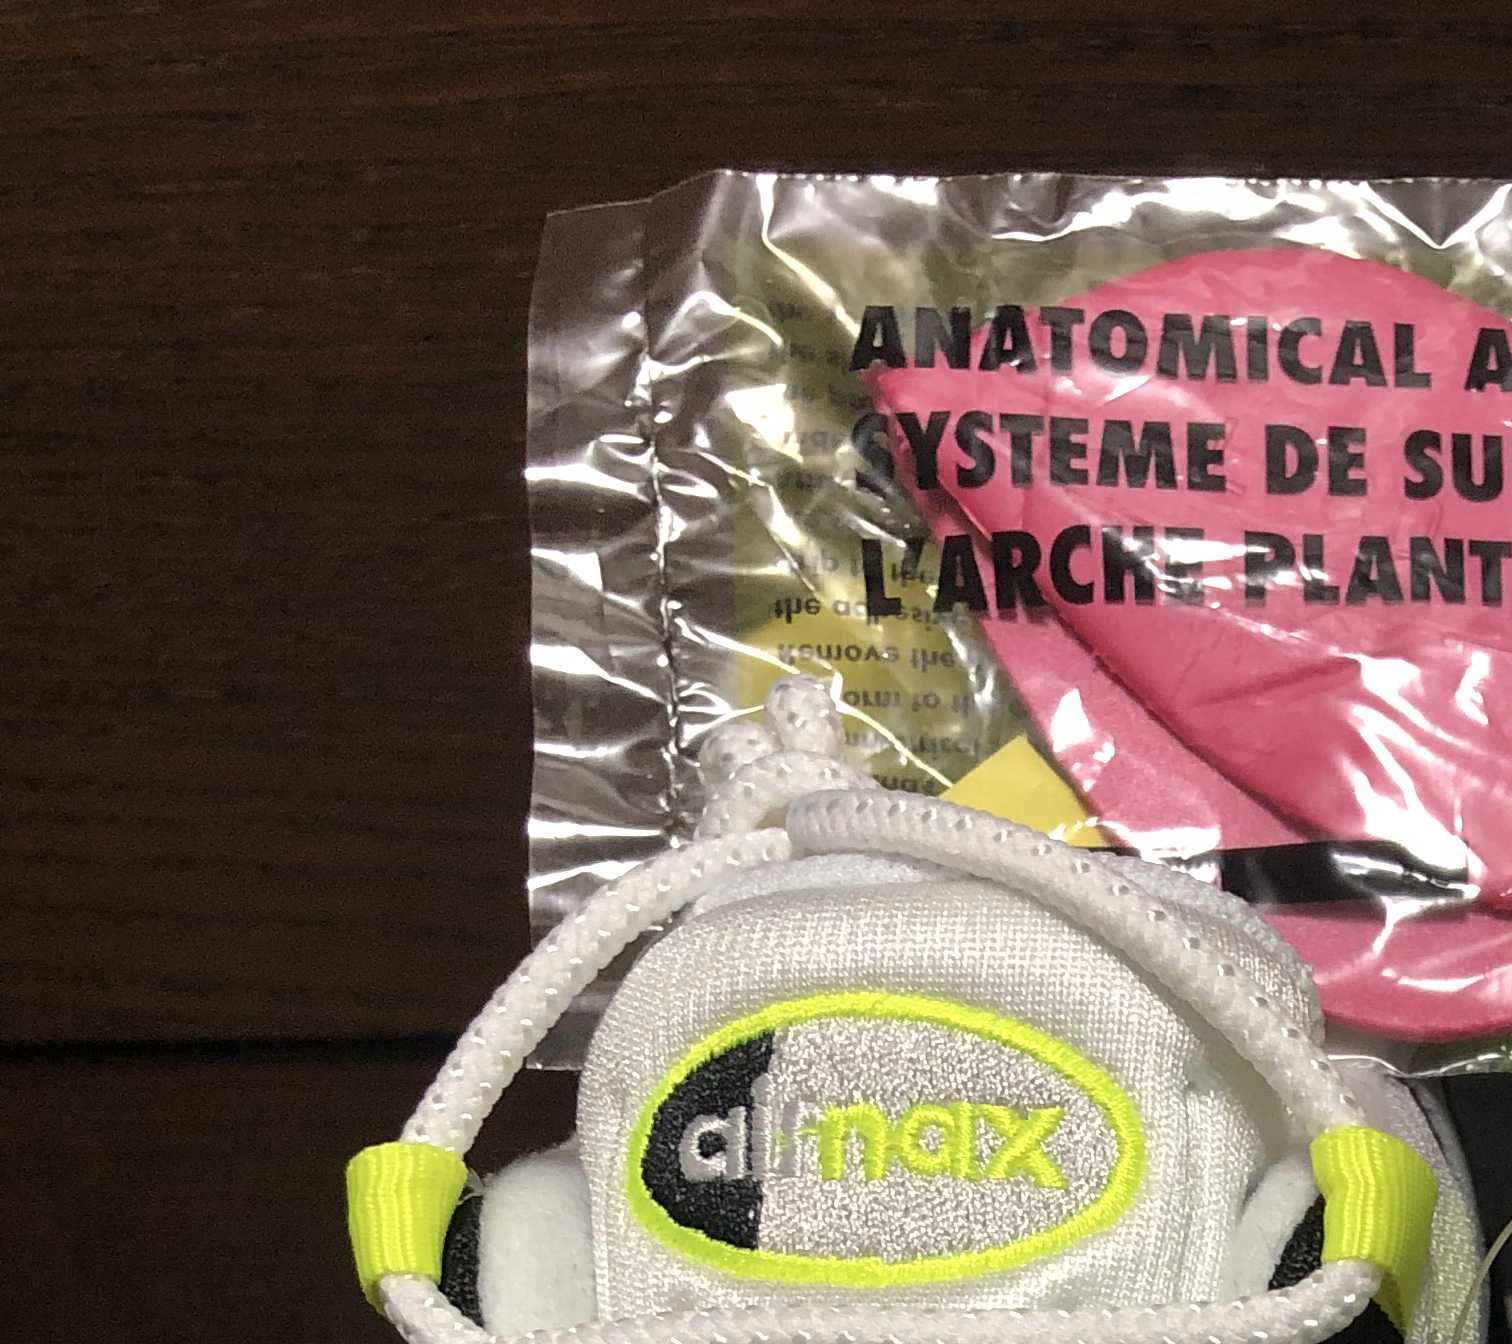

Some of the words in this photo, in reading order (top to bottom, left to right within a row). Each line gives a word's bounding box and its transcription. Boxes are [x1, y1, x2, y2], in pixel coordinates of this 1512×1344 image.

[849, 305, 1431, 389] ANATOMICAL
[851, 410, 1227, 493] SYSTEME
[1265, 424, 1367, 497] DE
